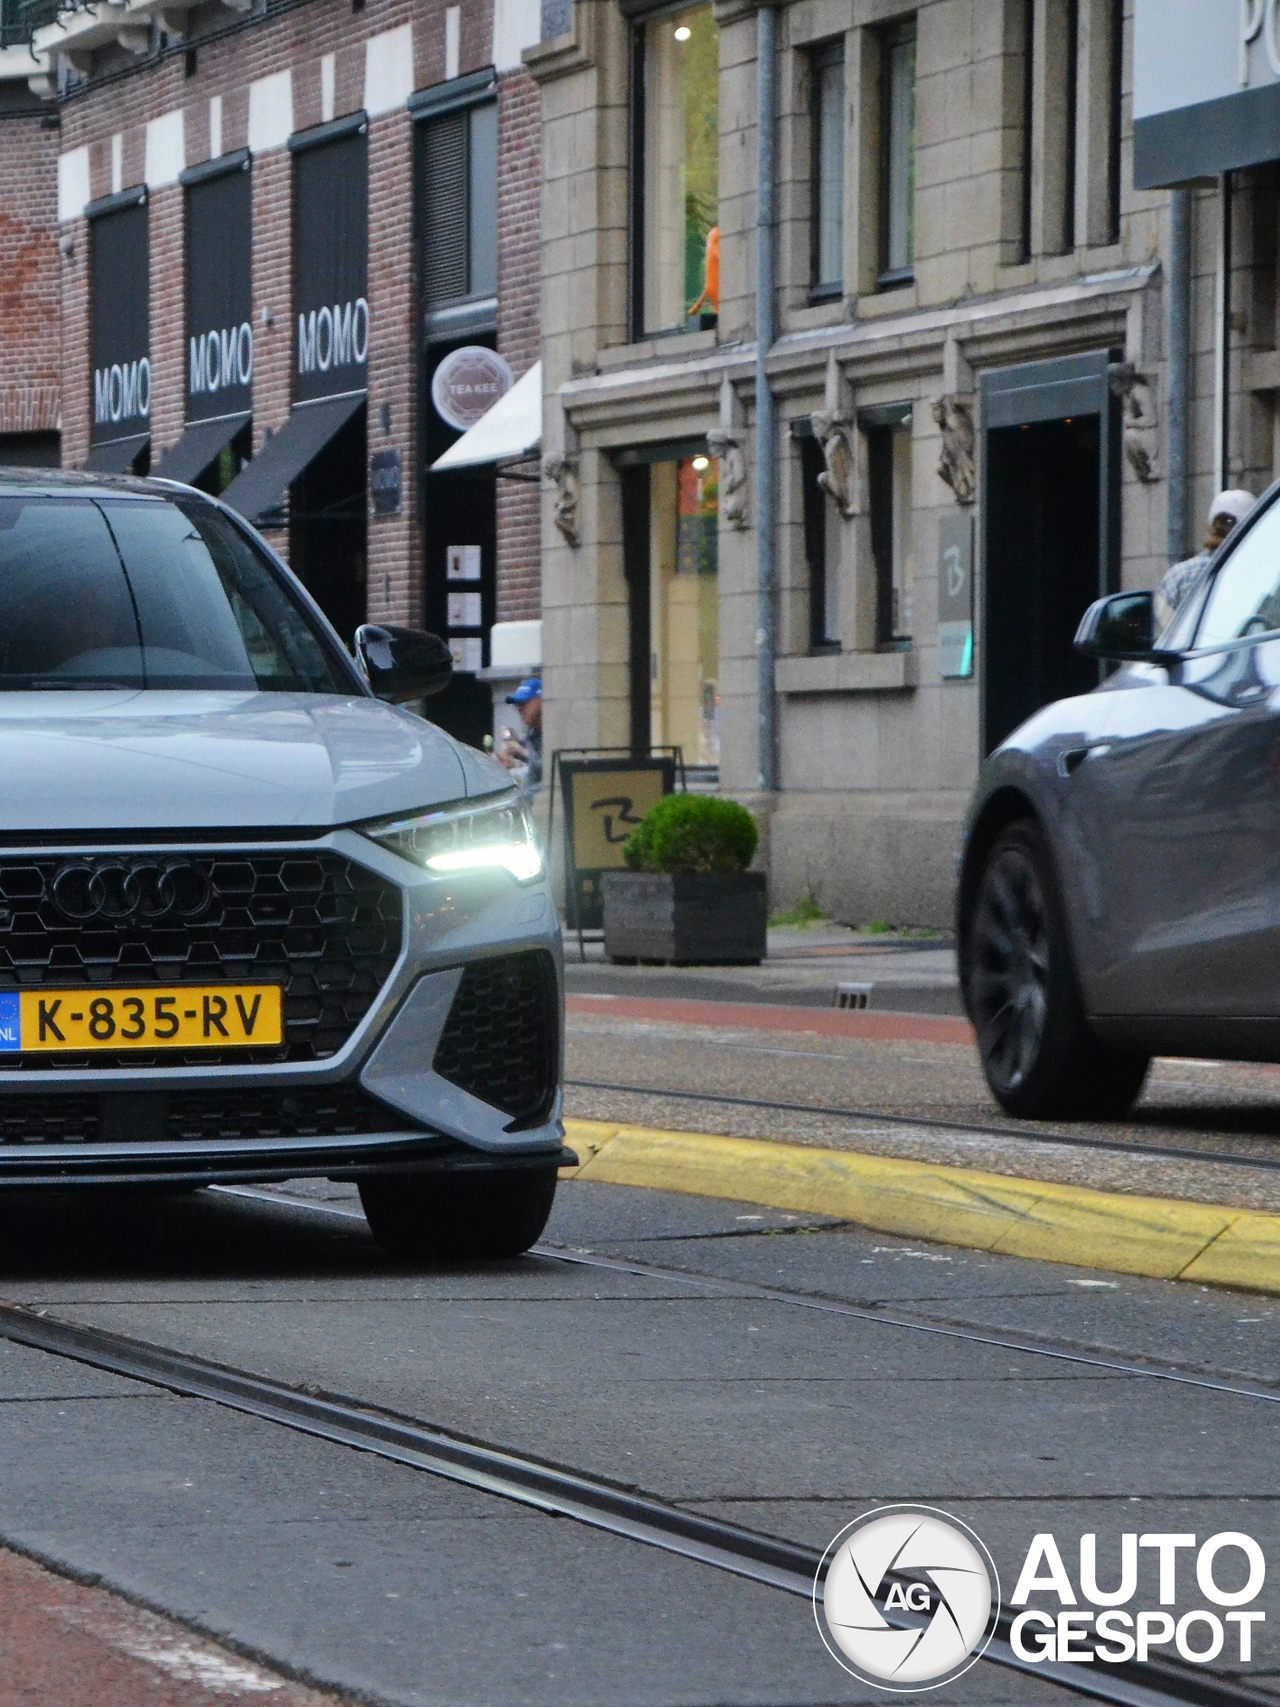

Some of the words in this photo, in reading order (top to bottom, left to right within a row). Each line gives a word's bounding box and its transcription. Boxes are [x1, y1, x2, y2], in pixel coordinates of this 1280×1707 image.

[190, 322, 253, 394] MOMO
[298, 297, 369, 374] MOMO
[95, 357, 151, 424] MOMO
[38, 994, 262, 1042] K-835-RV
